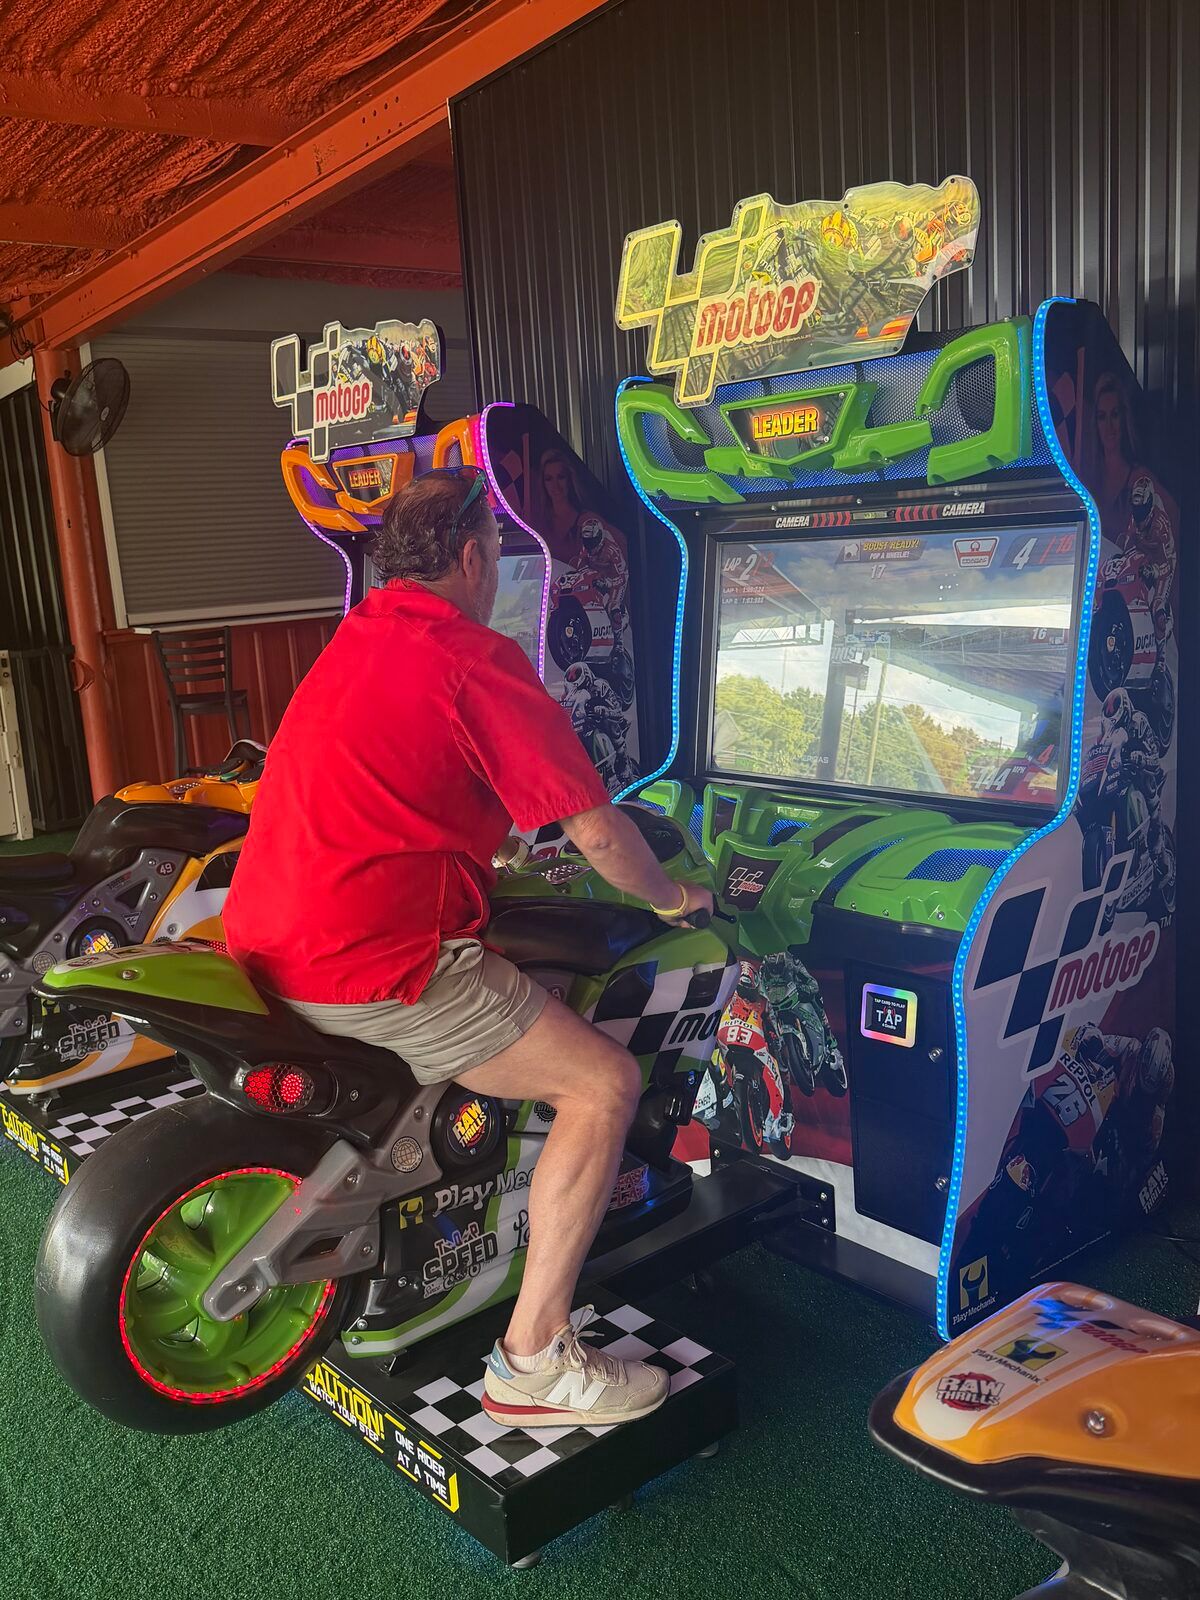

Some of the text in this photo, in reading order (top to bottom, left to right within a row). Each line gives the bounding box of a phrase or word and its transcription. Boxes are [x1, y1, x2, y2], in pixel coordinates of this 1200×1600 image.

[753, 407, 818, 439] LEADER
[349, 468, 381, 488] LEADER
[775, 515, 810, 528] CAMERA
[942, 502, 985, 517] CAMERA
[863, 538, 920, 551] BOOST READY!
[869, 552, 880, 560] POP
[1012, 537, 1038, 570] 4
[722, 557, 742, 572] LAP
[871, 563, 887, 578] 17
[1032, 627, 1047, 640] 16
[974, 768, 1012, 791] 144
[160, 862, 173, 875] 49
[876, 1009, 903, 1026] TAP
[59, 1021, 120, 1055] SPEED
[727, 1026, 752, 1045] 93
[1060, 1052, 1097, 1106] REPSOL
[1040, 1073, 1088, 1127] 26
[2, 1108, 39, 1152] CAUTION!
[452, 1099, 483, 1141] RAW
[459, 1111, 487, 1148] THRILLS
[433, 1181, 493, 1217] Play
[1138, 1159, 1167, 1207] RAW
[1143, 1174, 1169, 1214] THRILLS
[423, 1231, 498, 1281] SPEED
[952, 1296, 996, 1325] Play Mechanix
[972, 1348, 1042, 1384] Play Mechanix
[305, 1363, 385, 1440] AUTION!
[936, 1390, 1000, 1405] THRILLS
[937, 1376, 1005, 1397] RAW
[307, 1379, 380, 1443] WATCH YOUR STEP
[394, 1430, 446, 1480] ONE RIDER
[397, 1450, 448, 1500] AT A TIME
